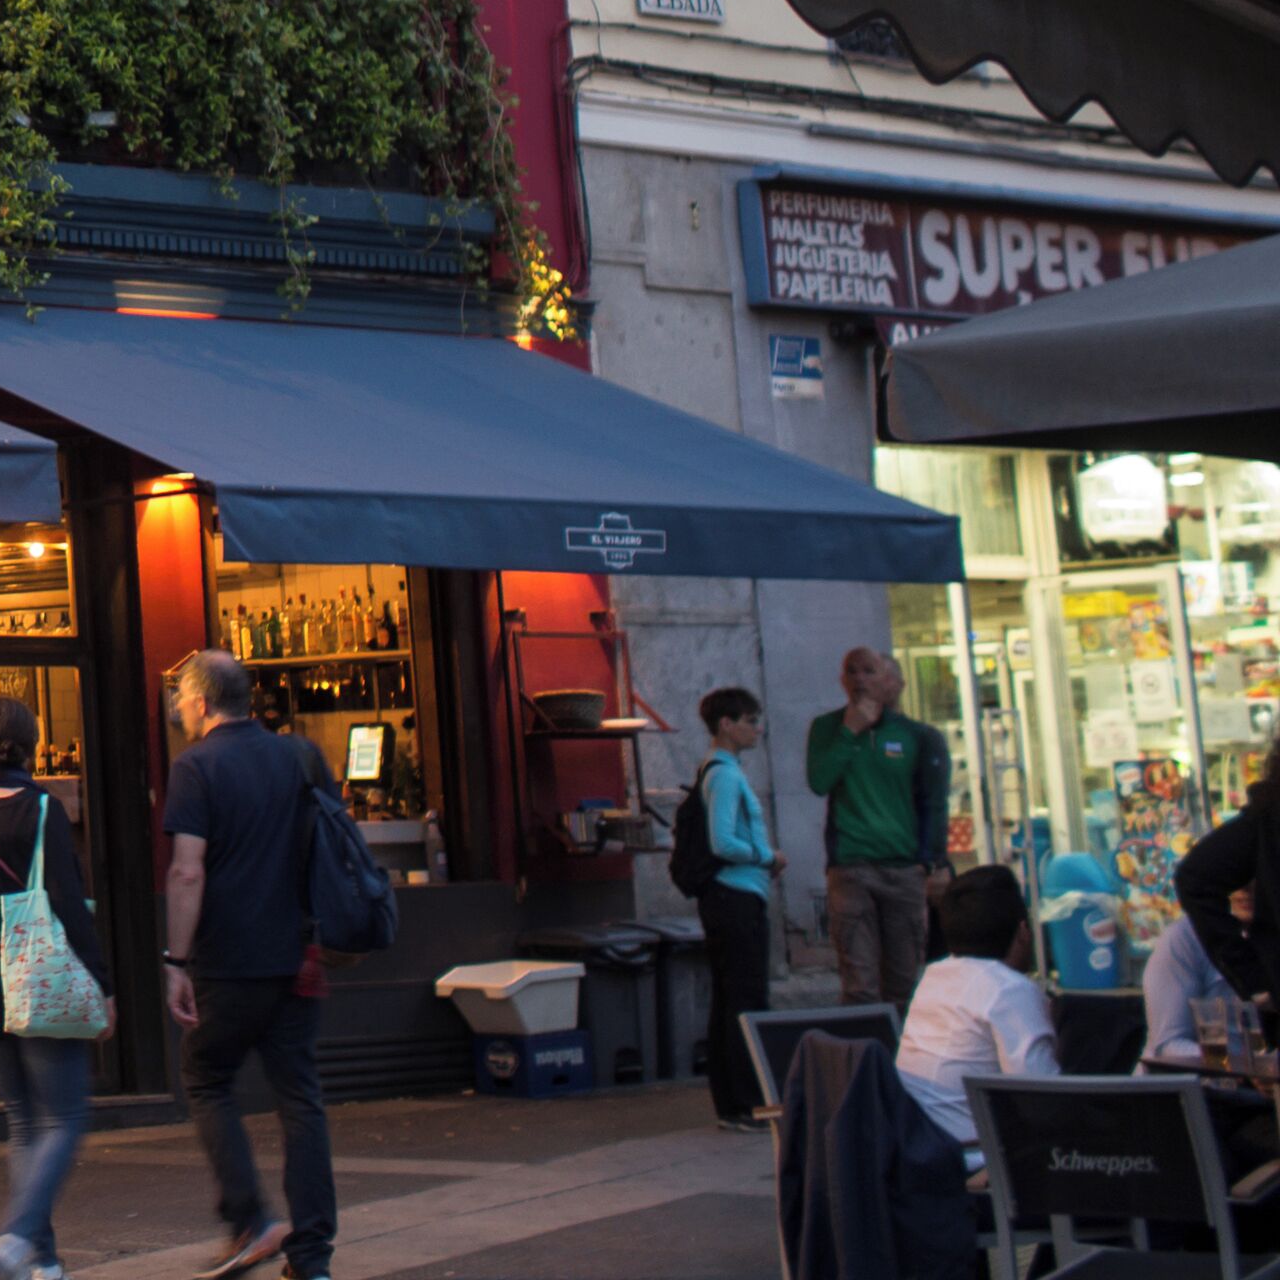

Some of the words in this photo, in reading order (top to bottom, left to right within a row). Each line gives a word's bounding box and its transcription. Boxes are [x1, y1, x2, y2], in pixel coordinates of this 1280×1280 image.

[770, 190, 895, 226] PERFUMERIA
[771, 216, 865, 248] MALETAS
[774, 243, 899, 280] JUGUETERIA
[919, 209, 1106, 306] SUPER
[775, 270, 895, 307] PAPELERIA
[591, 535, 602, 544] EL
[605, 536, 642, 545] VIAJERO
